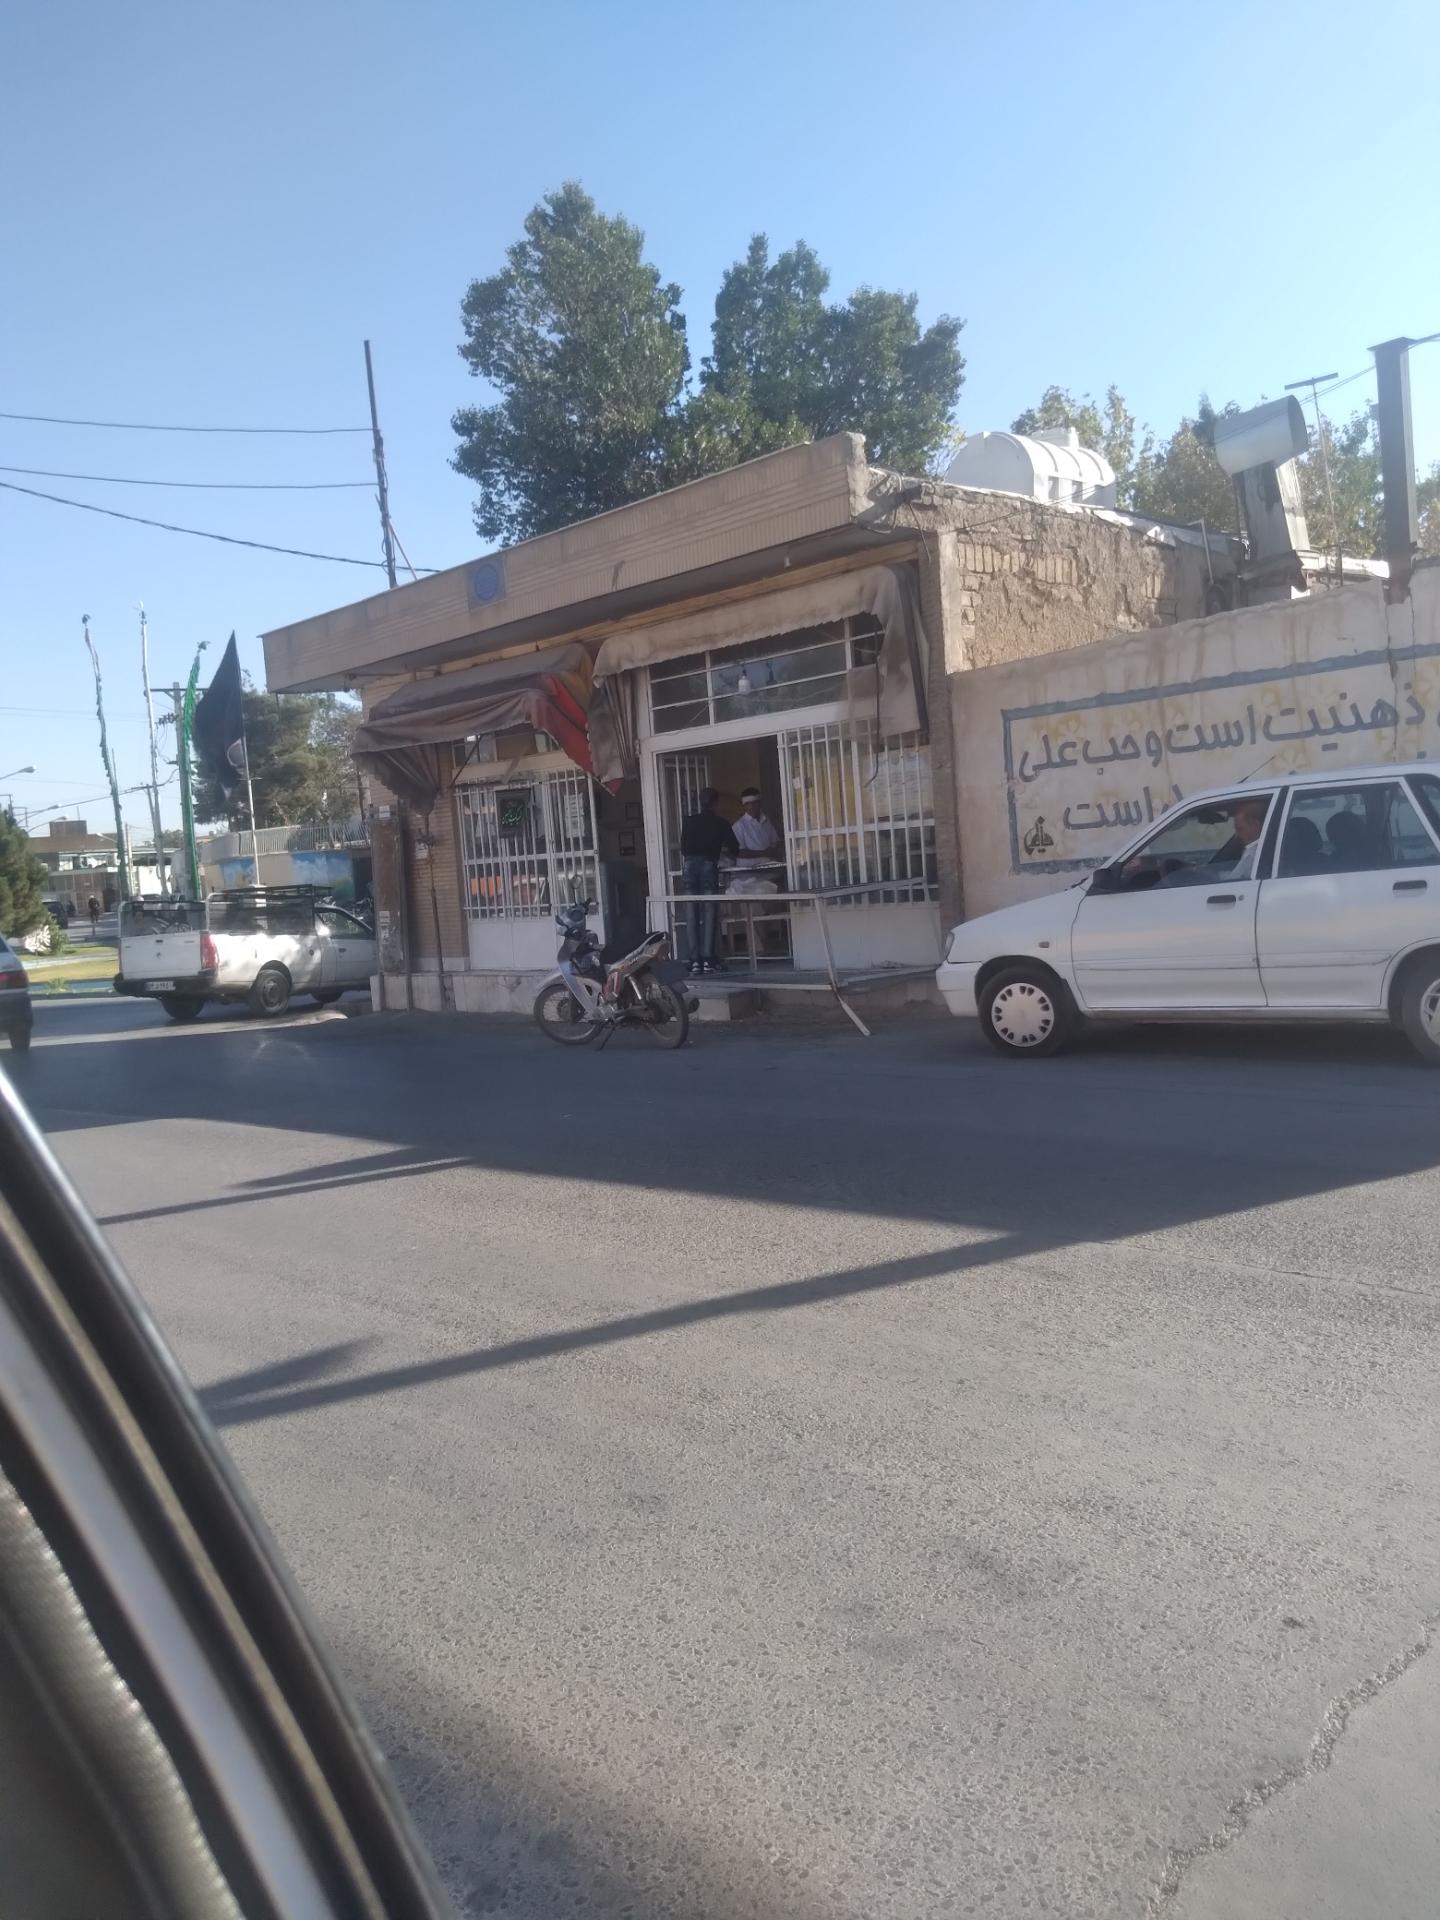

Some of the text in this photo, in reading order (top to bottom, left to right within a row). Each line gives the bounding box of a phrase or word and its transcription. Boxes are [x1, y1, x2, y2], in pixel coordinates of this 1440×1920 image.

[1165, 704, 1256, 754] است
[1018, 734, 1078, 783] علی
[1082, 734, 1141, 776] حب
[1063, 786, 1154, 830] است
